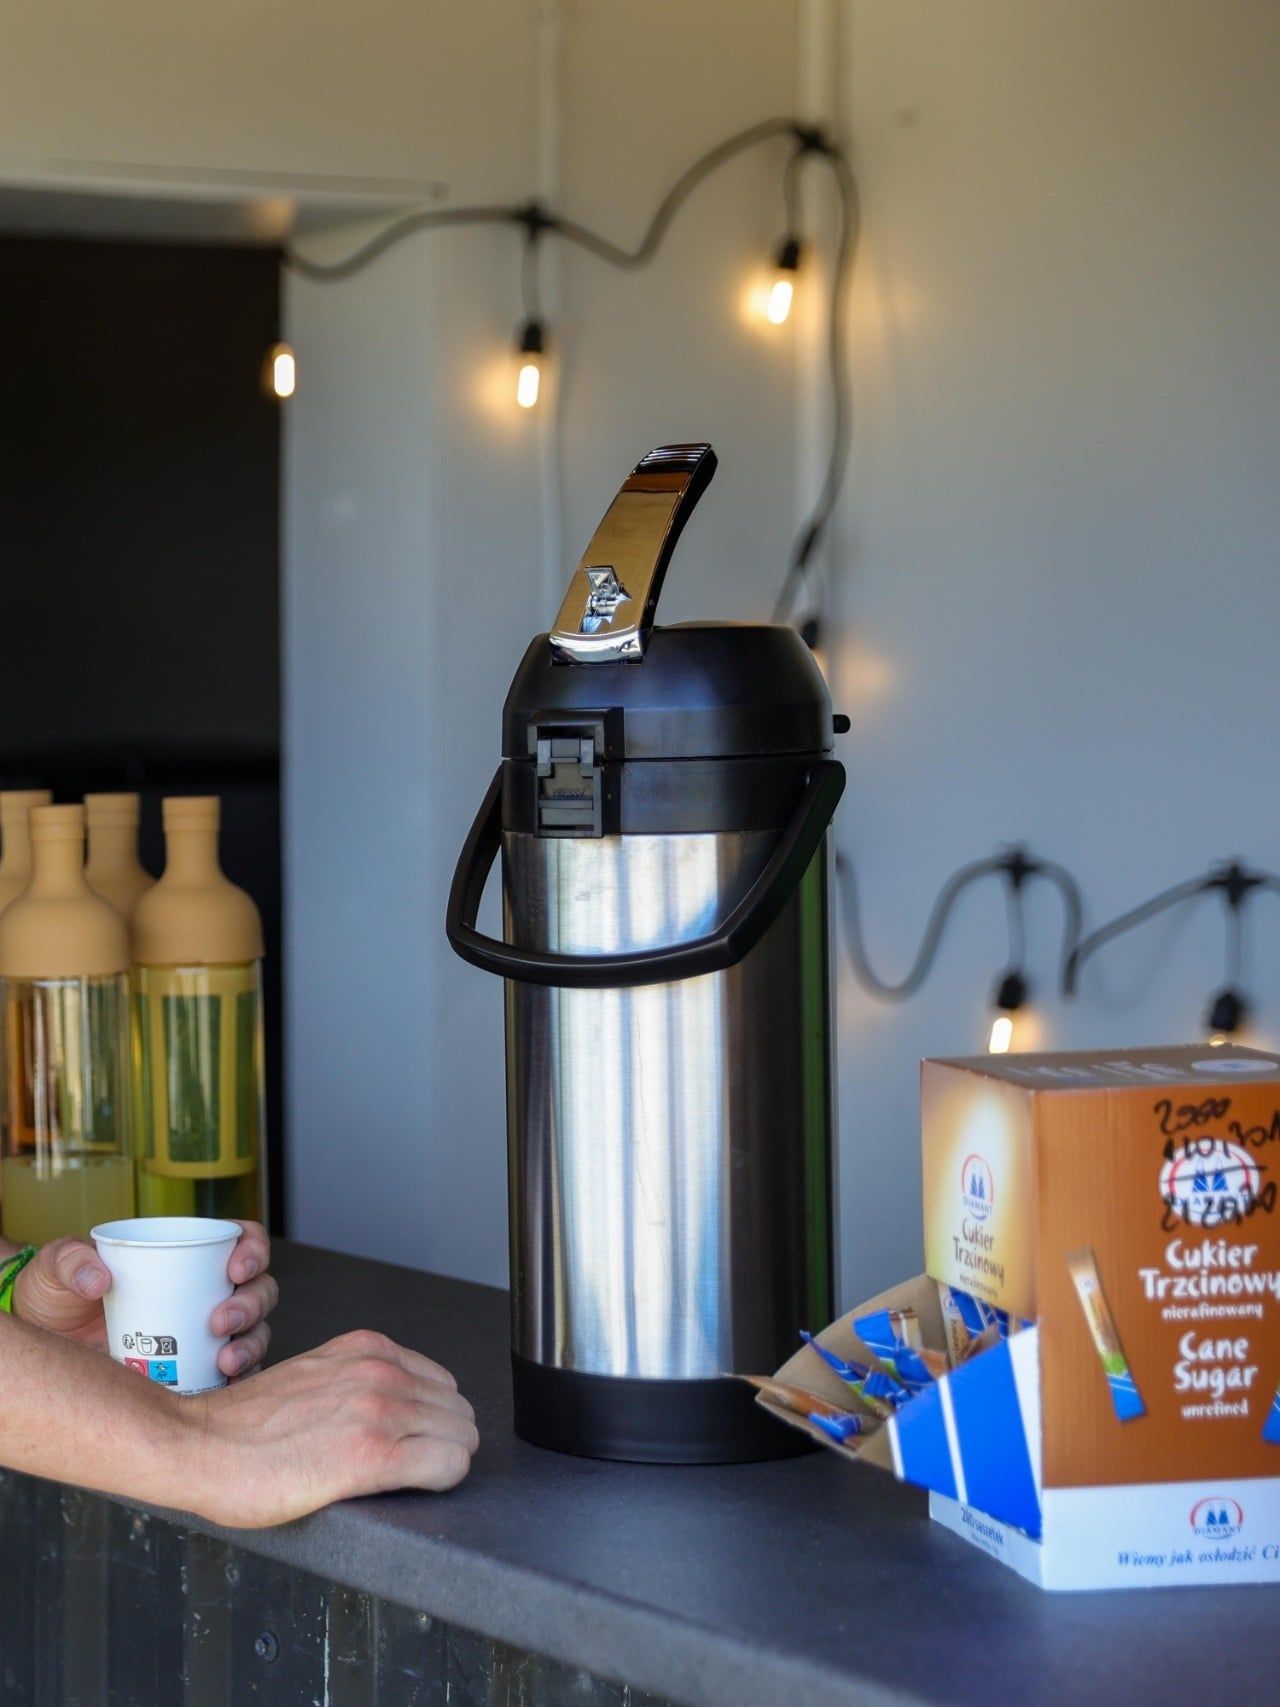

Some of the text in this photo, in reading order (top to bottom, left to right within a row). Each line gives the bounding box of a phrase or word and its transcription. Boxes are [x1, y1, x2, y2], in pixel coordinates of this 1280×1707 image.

[962, 1217, 995, 1251] Cukier
[953, 1236, 1005, 1288] Trzcinowy
[1165, 1238, 1258, 1269] Cukier
[1138, 1267, 1280, 1301] Trzcinowy
[1162, 1302, 1263, 1319] nierafinowany
[1179, 1329, 1249, 1361] Cane
[1173, 1360, 1259, 1398] Sugar
[1182, 1398, 1249, 1417] unrefined
[1194, 1526, 1242, 1536] DIAMANT
[1118, 1551, 1166, 1568] Wiemy
[1169, 1549, 1193, 1567] jak
[1199, 1545, 1257, 1563] osłodzić
